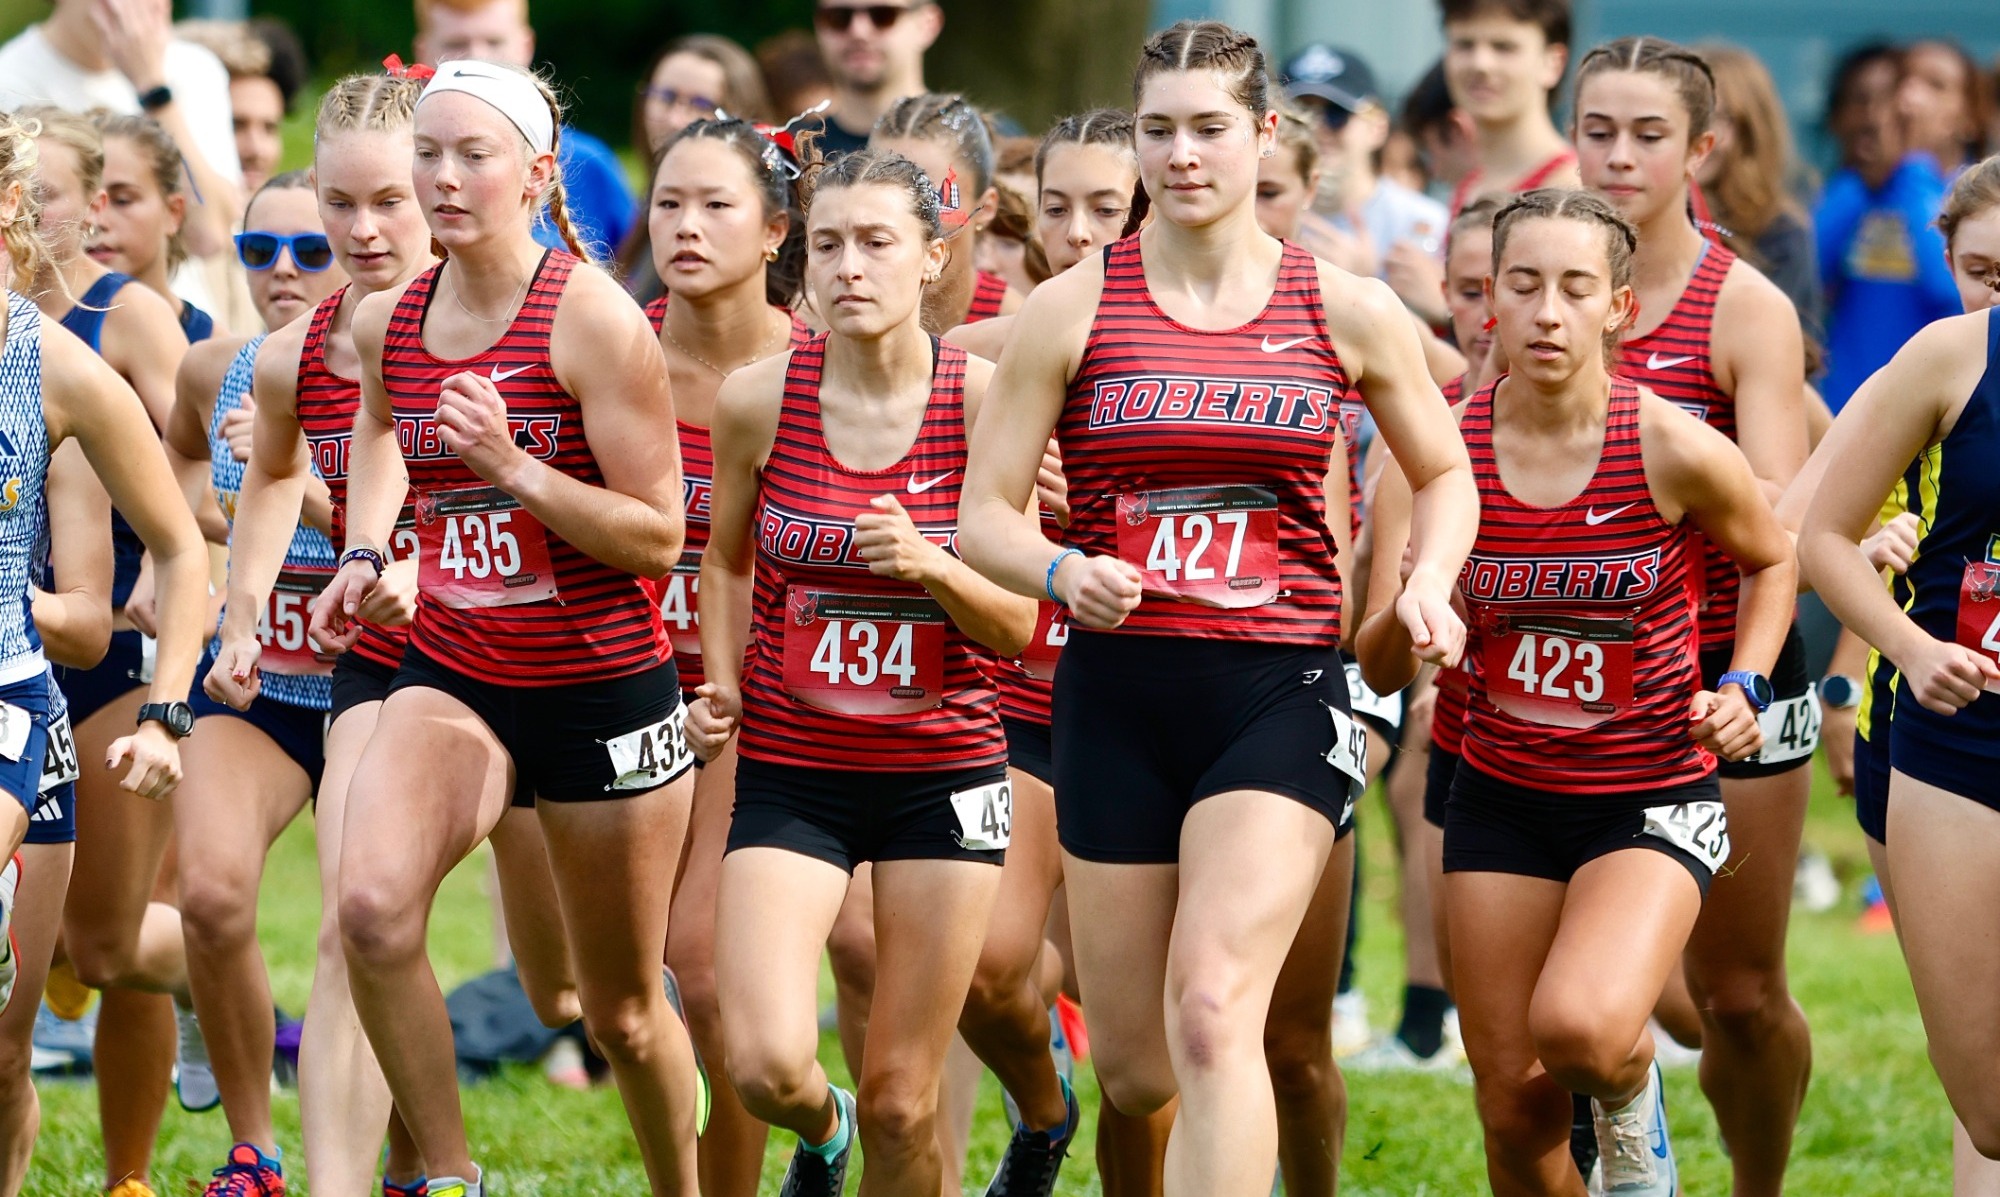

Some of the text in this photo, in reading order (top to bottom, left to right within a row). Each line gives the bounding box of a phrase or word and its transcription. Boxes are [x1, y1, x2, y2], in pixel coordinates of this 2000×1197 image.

[1091, 378, 1331, 433] ROBERTS
[440, 512, 522, 580] 435
[1146, 511, 1248, 581] 427
[809, 620, 917, 687] 434
[1507, 634, 1604, 702] 423
[1668, 803, 1728, 859] 423
